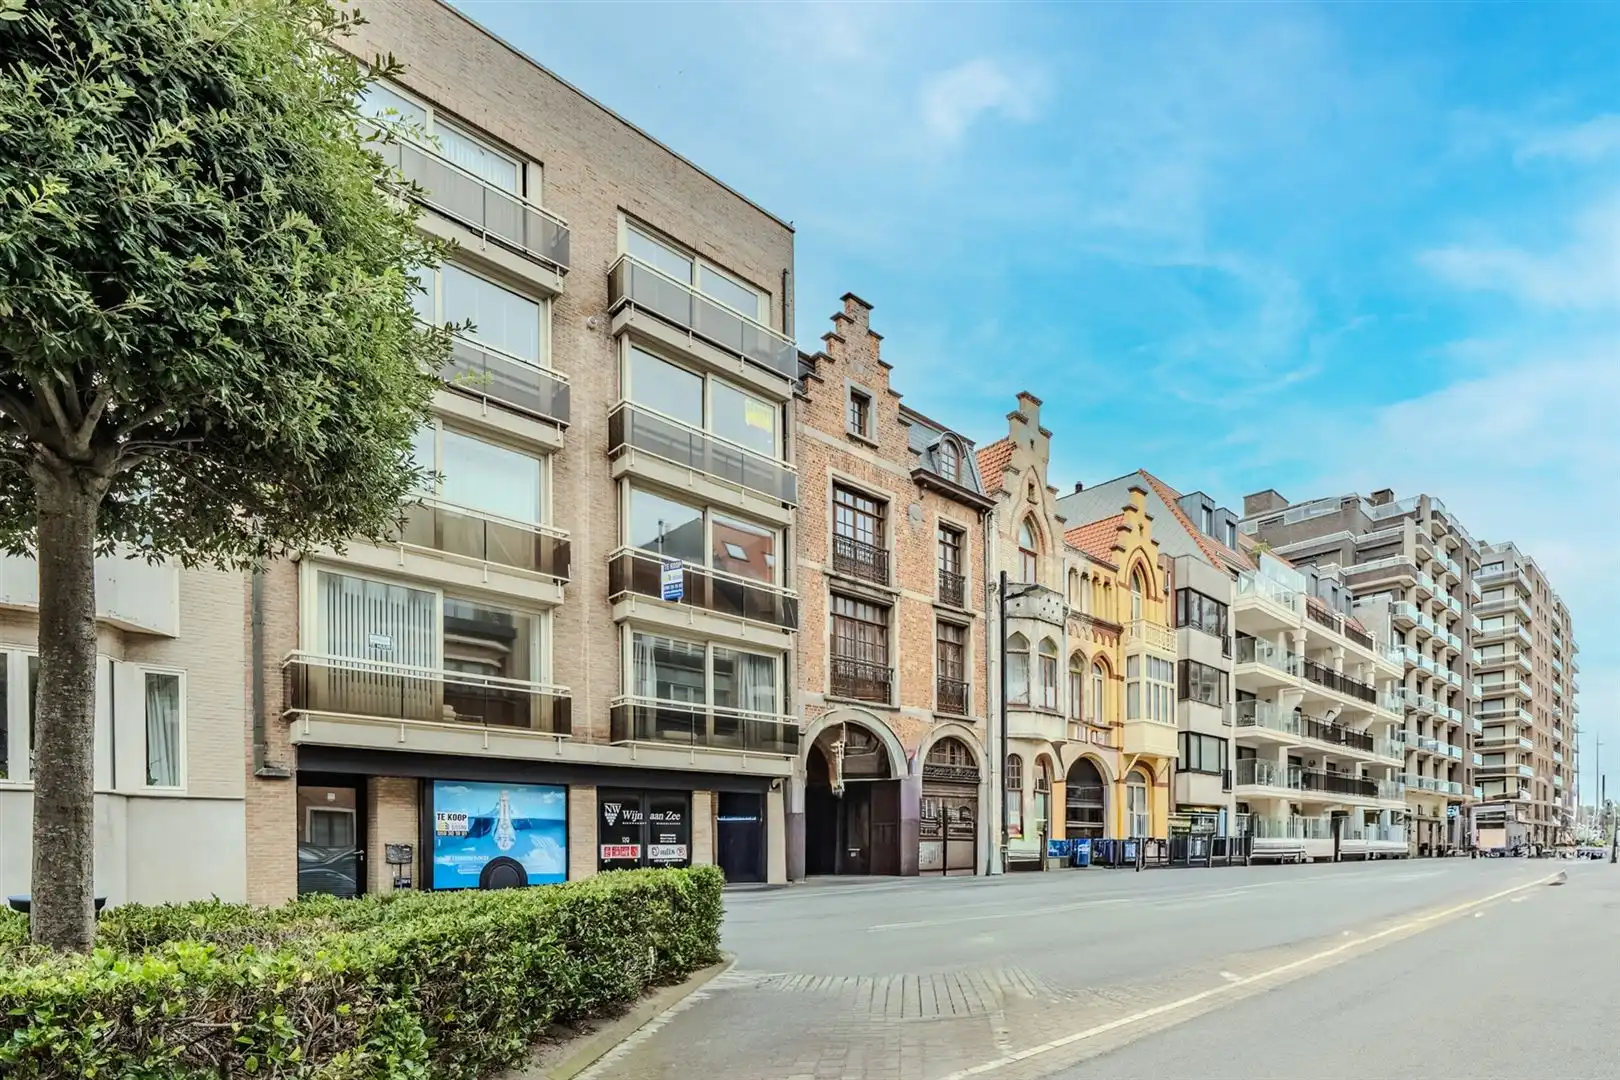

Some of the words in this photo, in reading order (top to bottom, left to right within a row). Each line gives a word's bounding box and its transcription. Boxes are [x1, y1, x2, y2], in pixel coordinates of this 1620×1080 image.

[437, 813, 446, 821] TE
[622, 810, 643, 822] Wijn
[665, 811, 681, 821] Zee
